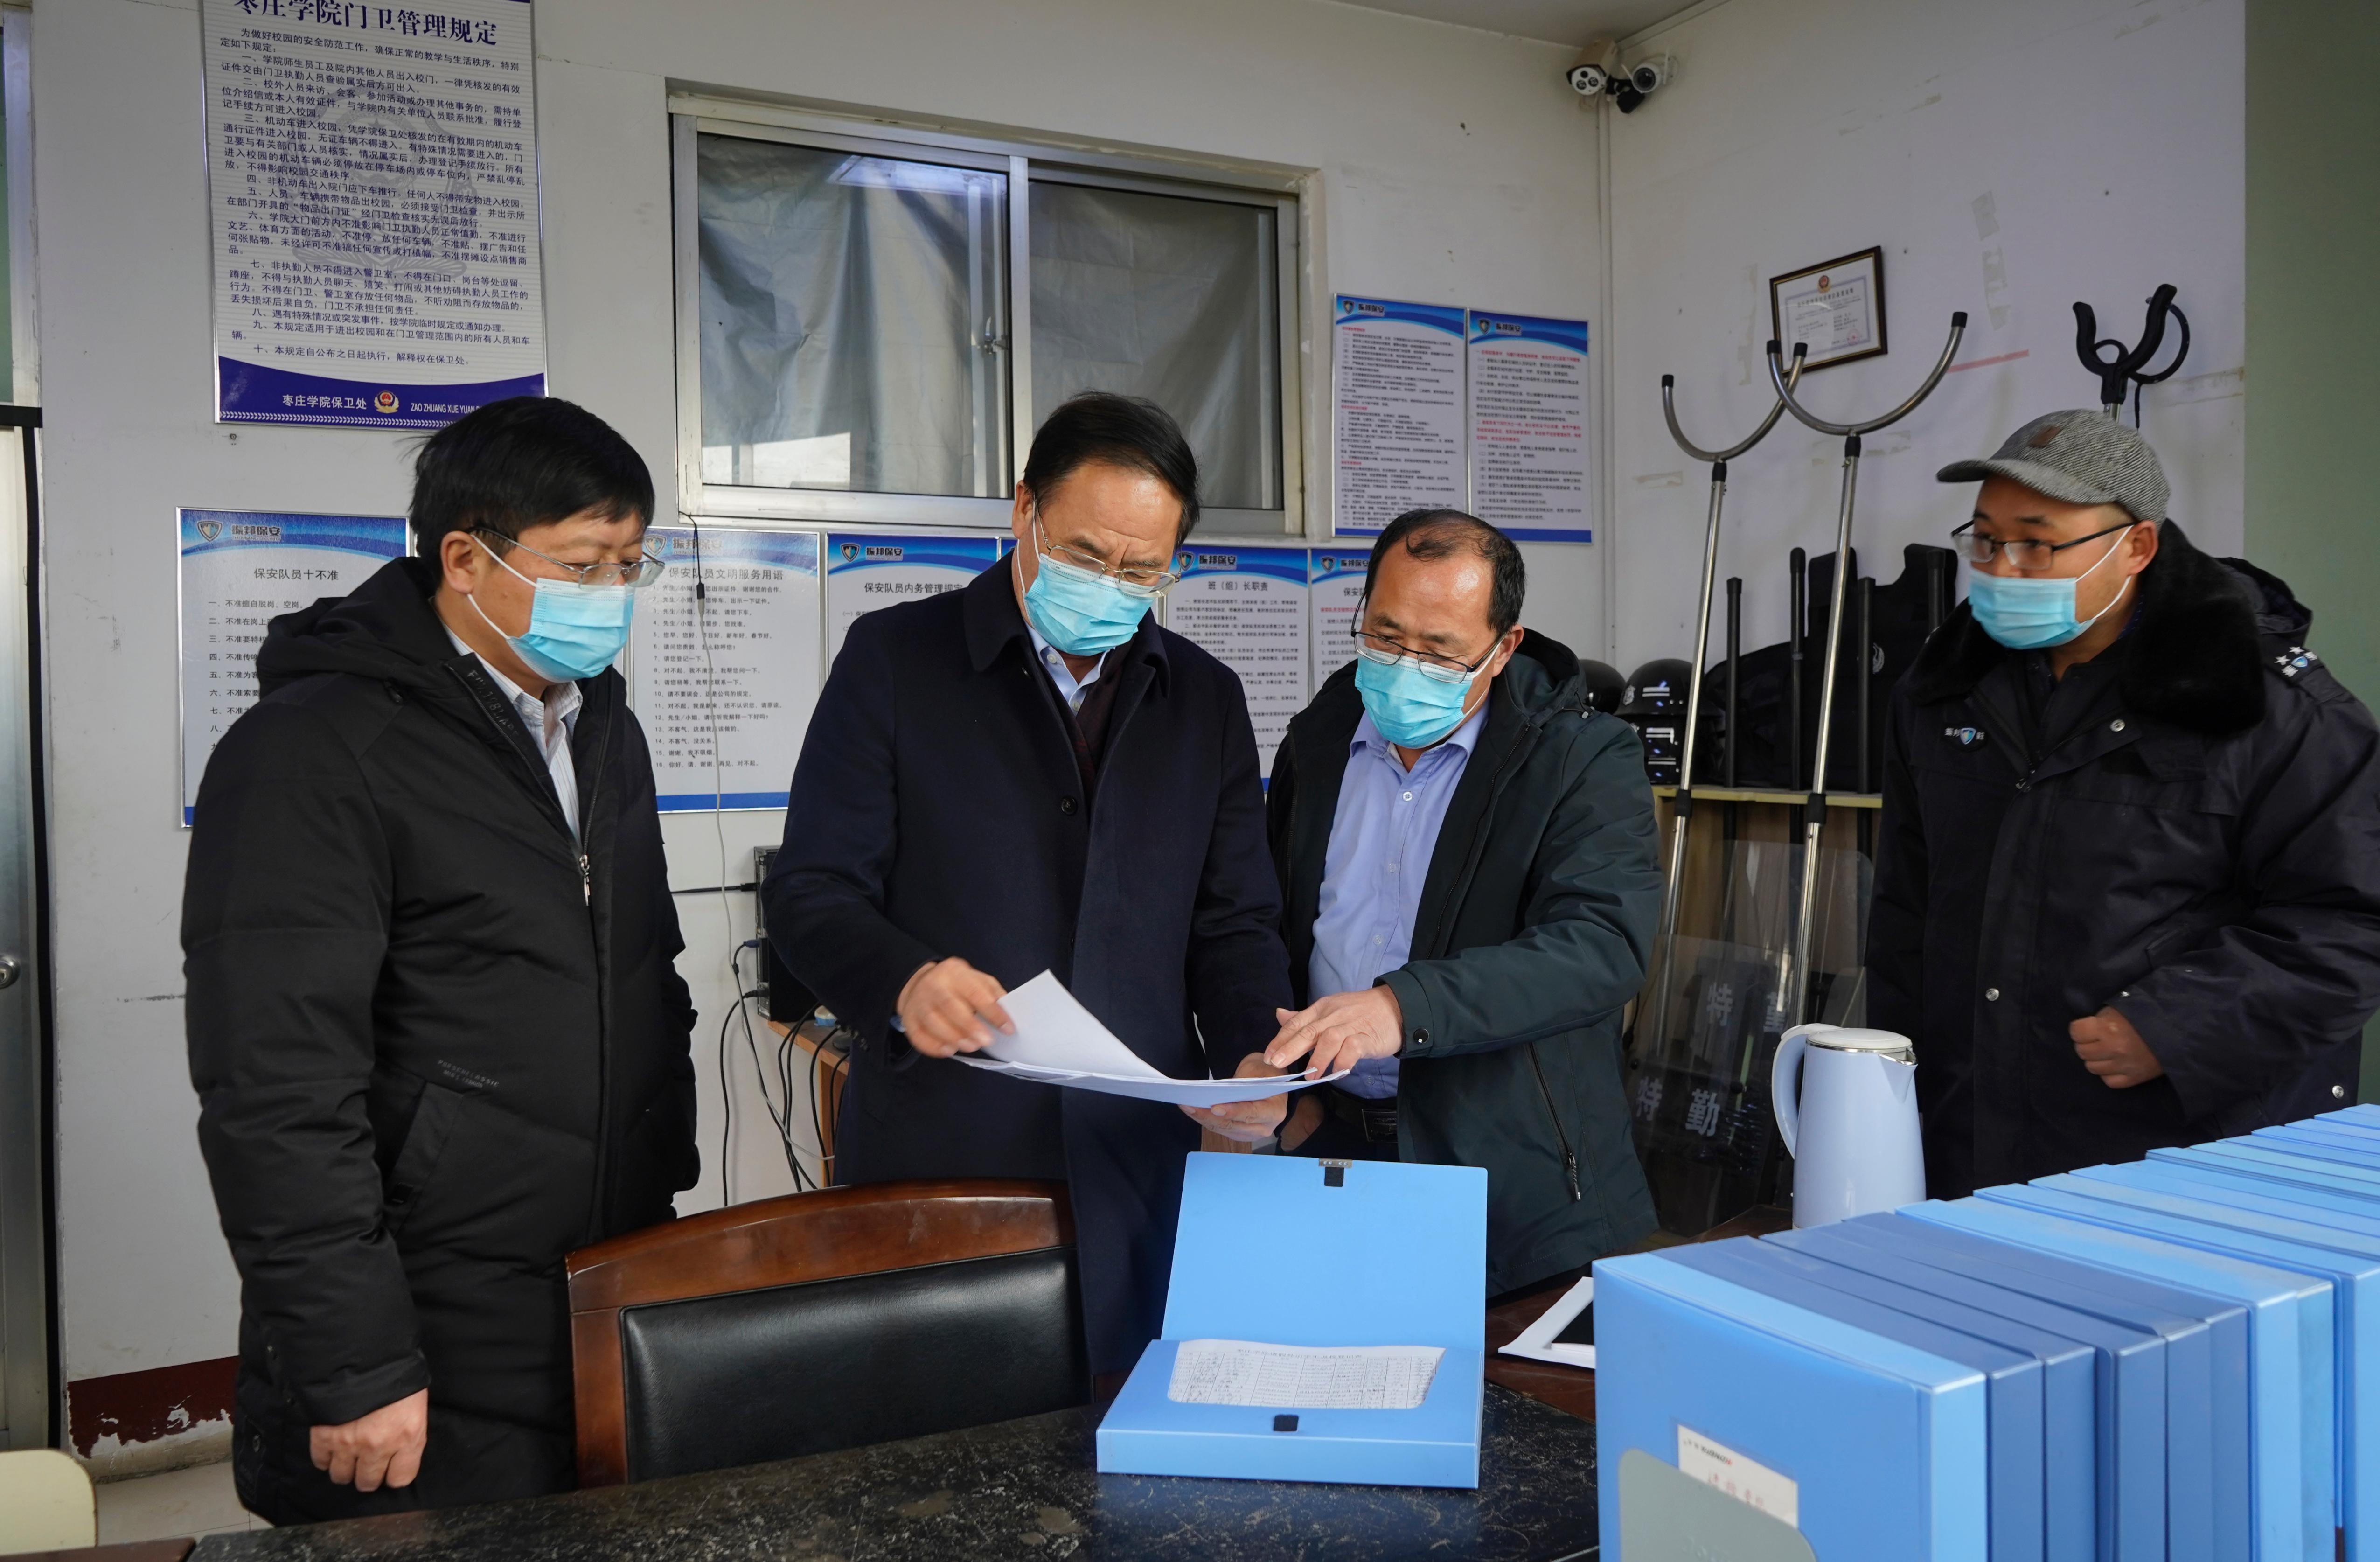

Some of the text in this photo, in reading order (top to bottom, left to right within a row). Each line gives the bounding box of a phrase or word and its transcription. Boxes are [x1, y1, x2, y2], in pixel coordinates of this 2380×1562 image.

[219, 37, 277, 53] 定如下规定：
[228, 244, 244, 254] 品。
[231, 330, 248, 340] 辆。
[282, 394, 367, 410] 枣庄学院保卫处
[411, 403, 422, 411] ZAO
[424, 403, 446, 413] ZHUANG
[447, 404, 459, 414] XUE
[460, 405, 475, 414] YUAN
[866, 547, 903, 556] 振邦保安
[254, 568, 339, 581] 保安队员十不准
[669, 567, 784, 580] 保安队员文明服务用语
[1208, 581, 1268, 592] 班（组）长职责
